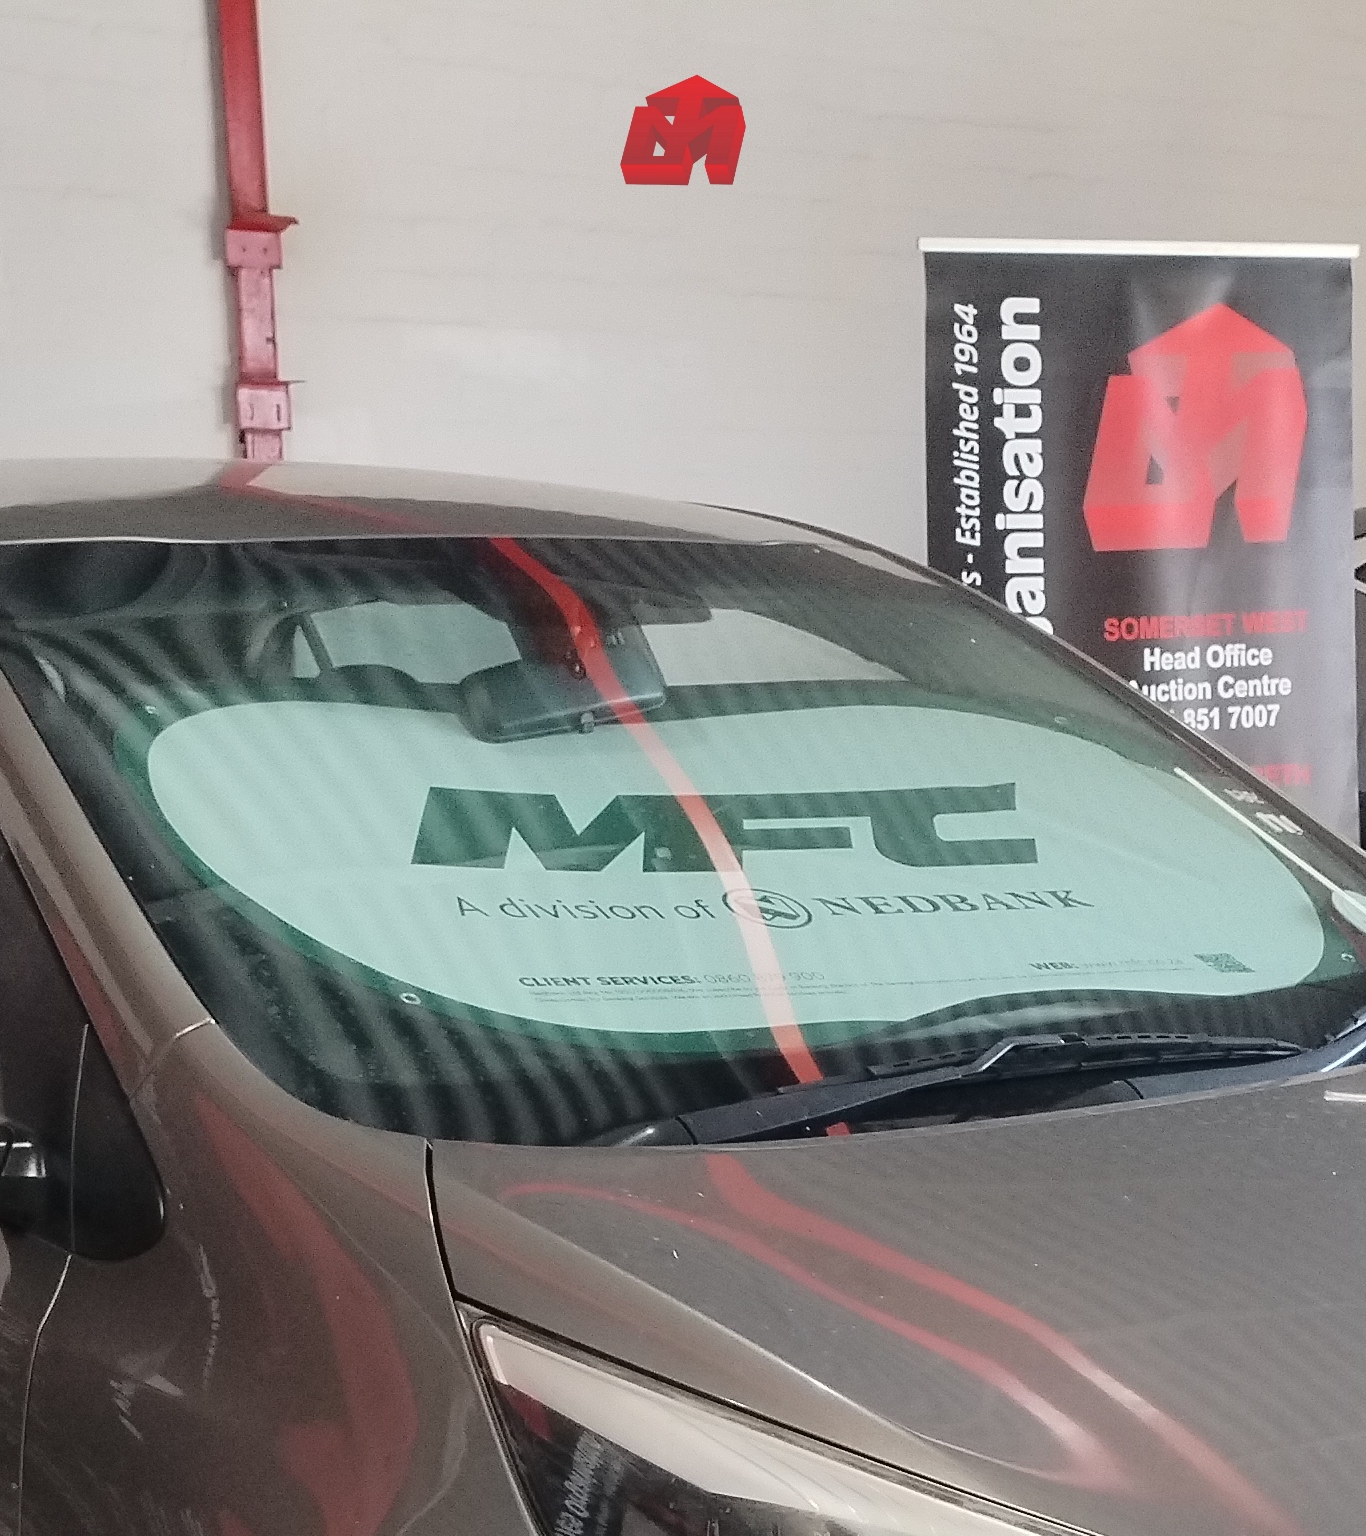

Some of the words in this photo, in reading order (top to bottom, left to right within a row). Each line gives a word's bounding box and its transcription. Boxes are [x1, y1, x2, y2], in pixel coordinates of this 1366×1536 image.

[953, 303, 978, 376] 1964
[952, 382, 981, 547] Established
[1103, 613, 1236, 642] SOMERSET
[1242, 608, 1308, 635] WEST
[1143, 646, 1201, 672] Head
[1206, 643, 1273, 669] Office
[1217, 674, 1293, 700] Centre
[1183, 707, 1220, 732] 851
[1228, 703, 1281, 730] 7007
[410, 782, 1038, 873] MFC
[456, 896, 490, 918] A
[499, 897, 666, 920] division
[673, 899, 716, 920] of
[810, 890, 1095, 916] NEDBANK
[1028, 961, 1080, 971] WEB:
[518, 976, 592, 988] CLIENT
[596, 974, 701, 987] SERVICES:
